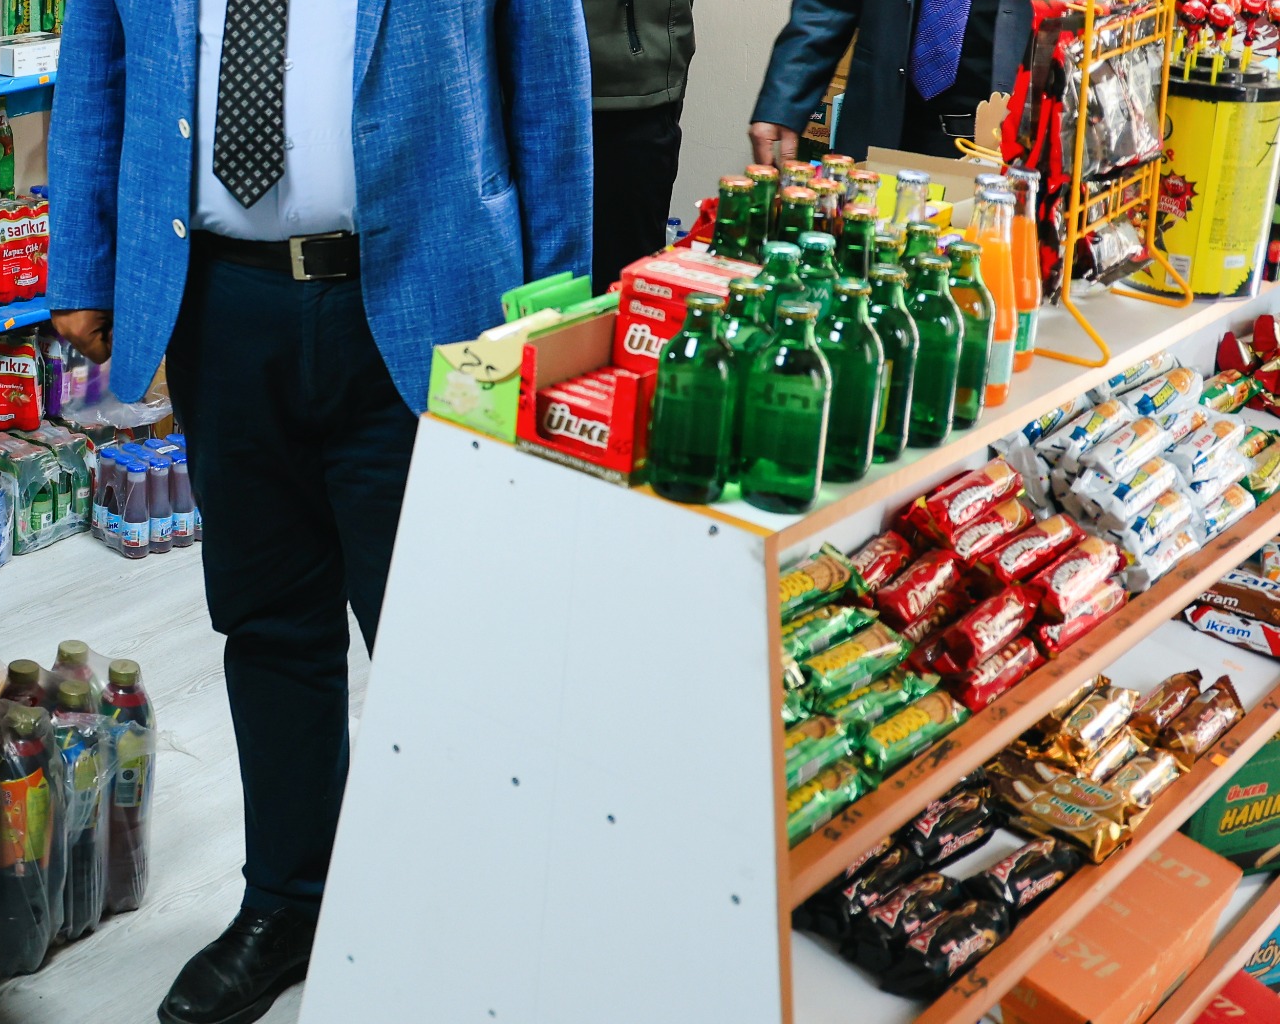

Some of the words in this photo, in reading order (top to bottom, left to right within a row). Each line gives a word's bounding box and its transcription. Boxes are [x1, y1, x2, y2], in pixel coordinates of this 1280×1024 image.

[7, 219, 47, 238] sarıkız
[1206, 619, 1251, 638] ikram
[1227, 781, 1268, 801] ÜLKER
